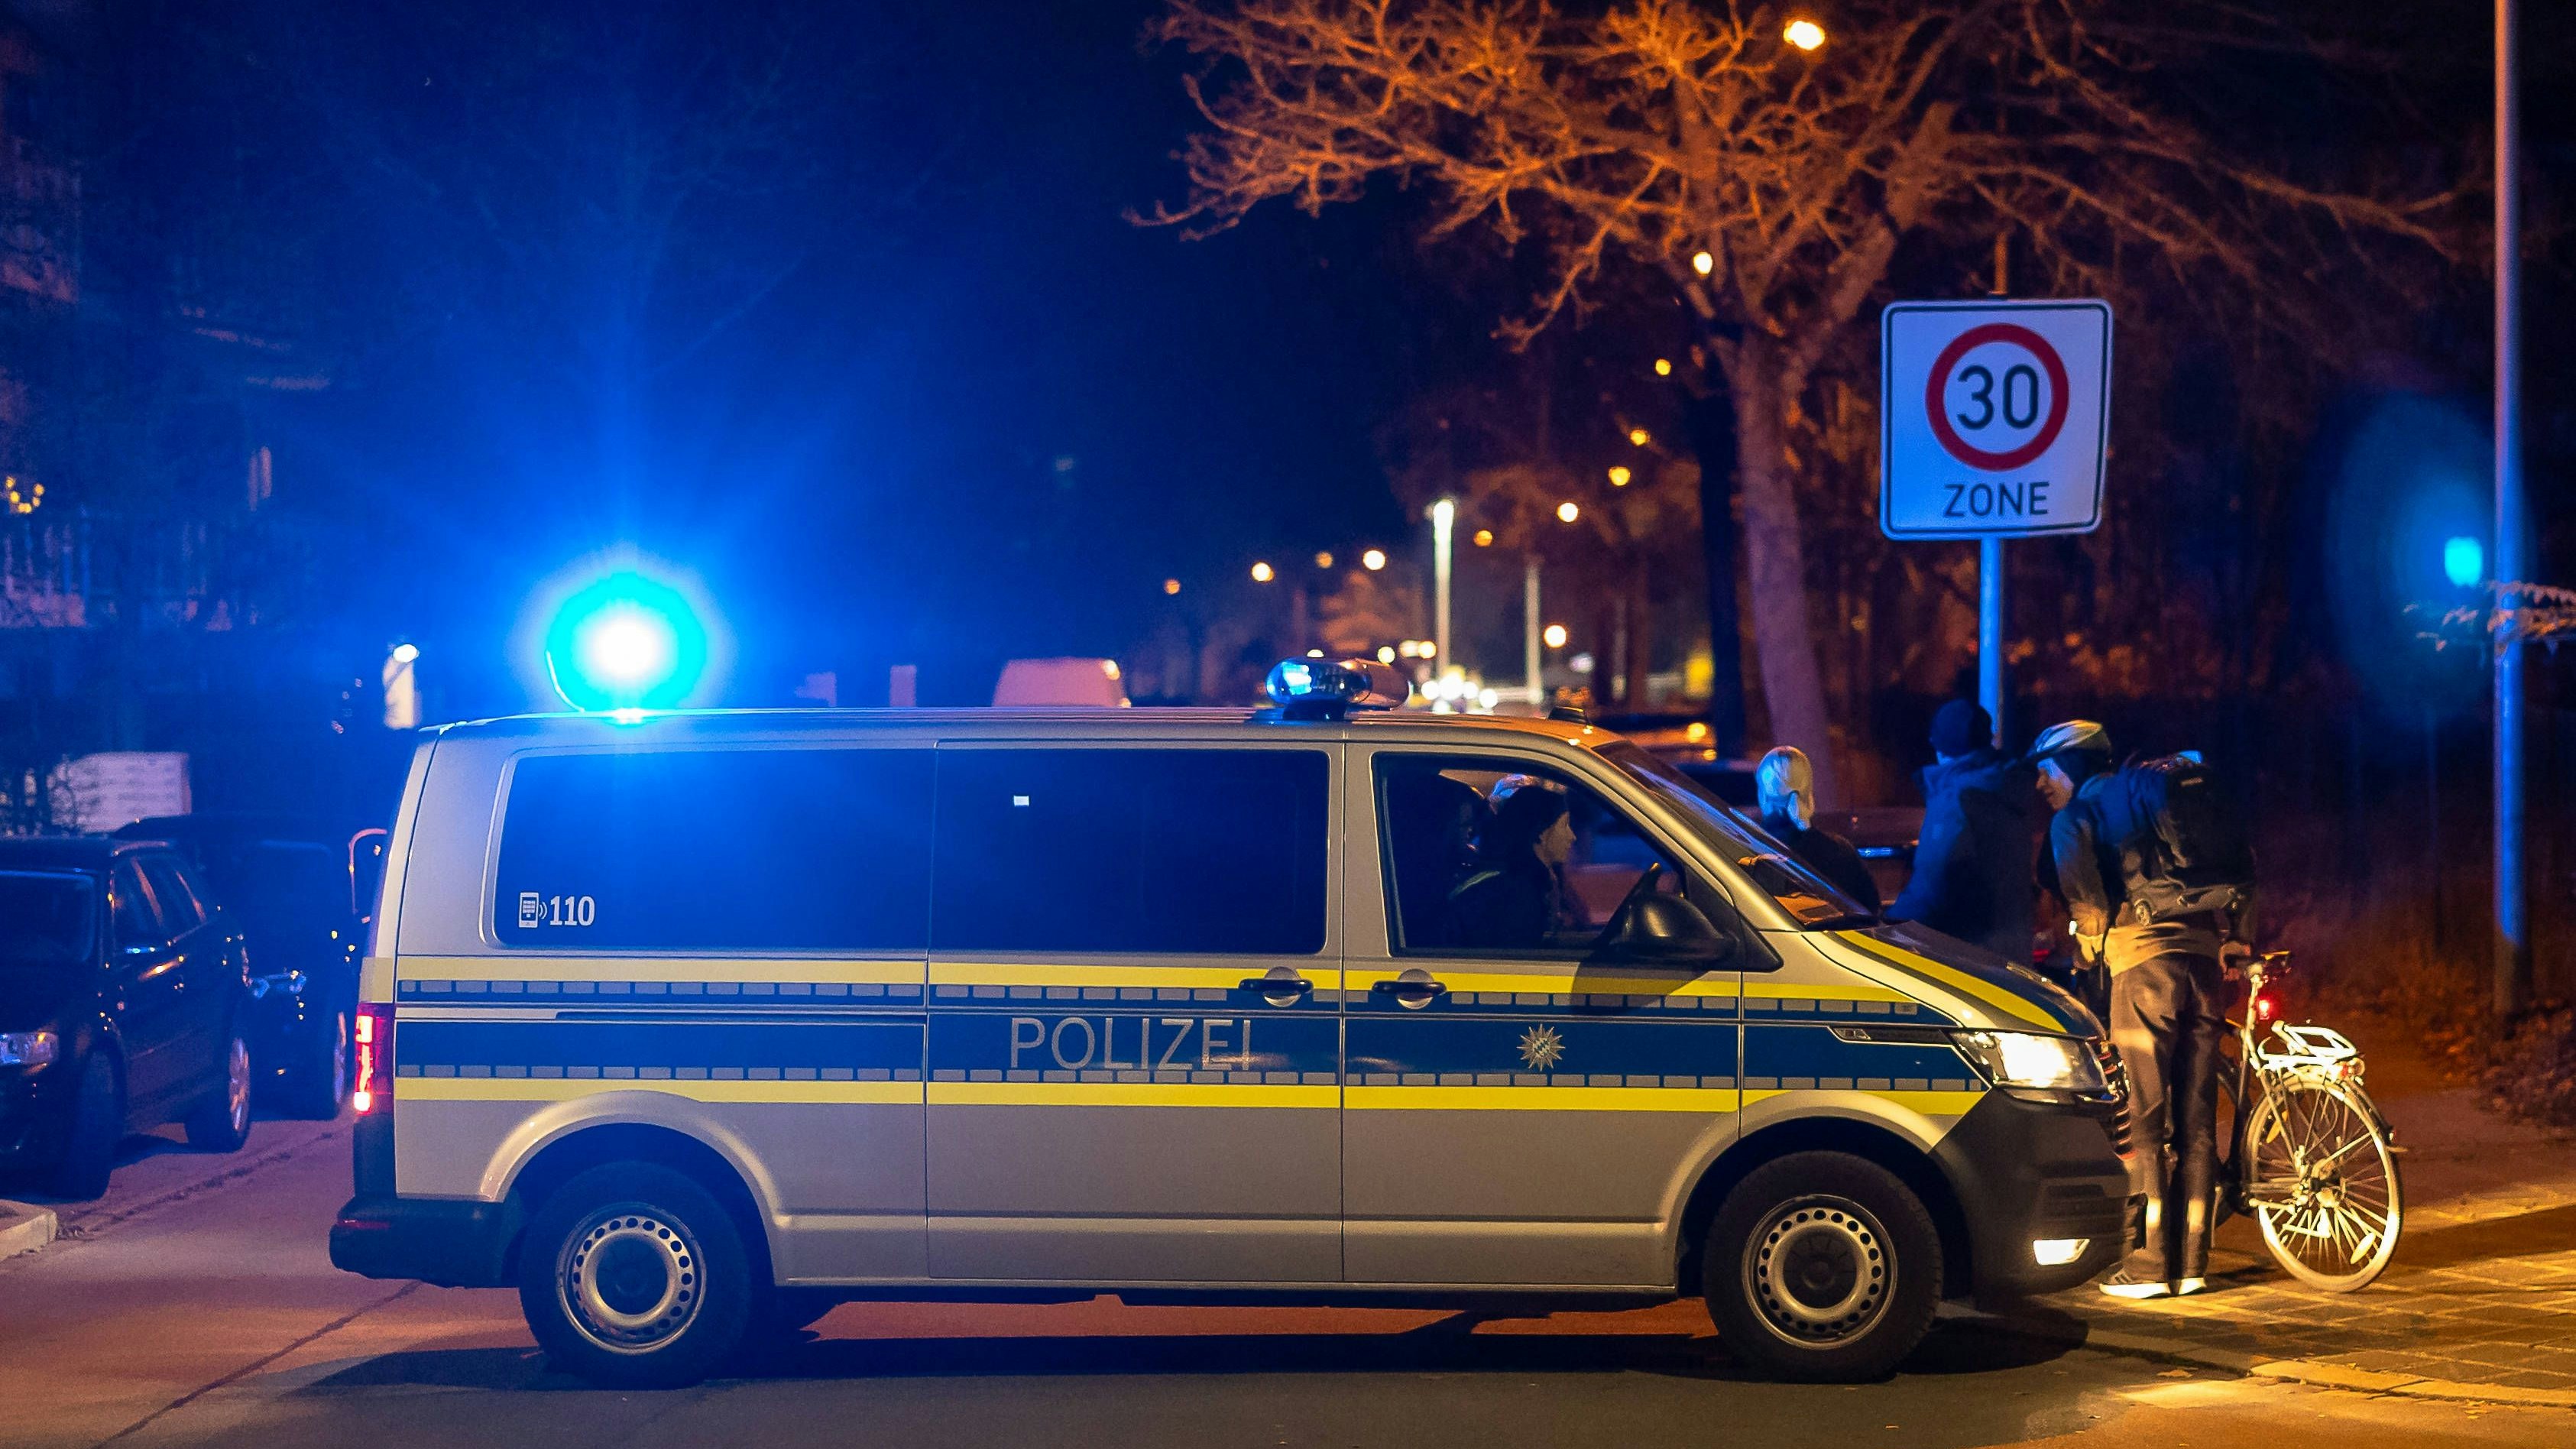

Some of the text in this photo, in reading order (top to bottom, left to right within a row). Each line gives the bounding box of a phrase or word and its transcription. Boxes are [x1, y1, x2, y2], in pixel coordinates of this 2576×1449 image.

[1957, 364, 2039, 430] 30
[1943, 481, 2049, 517] ZONE
[550, 896, 595, 926] 110
[1010, 1016, 1251, 1070] POLIZEI
